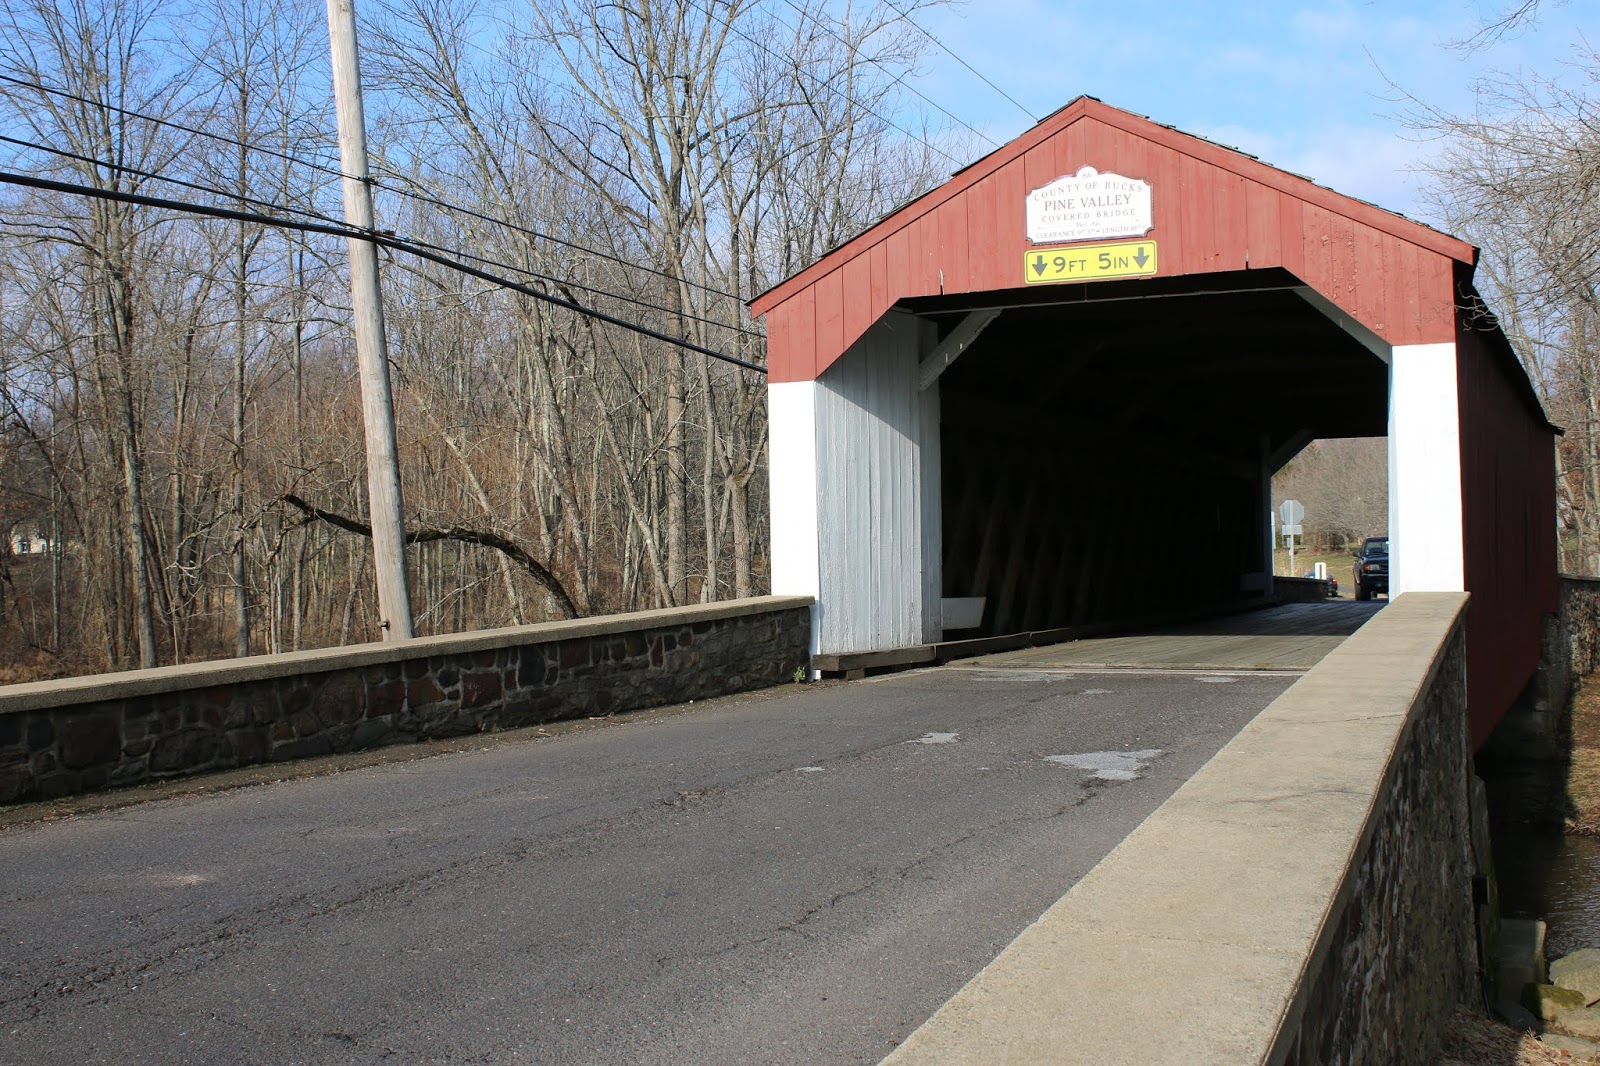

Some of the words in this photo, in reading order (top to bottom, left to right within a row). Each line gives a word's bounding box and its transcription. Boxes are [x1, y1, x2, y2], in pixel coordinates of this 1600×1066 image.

[1034, 183, 1081, 201] COUNTY
[1085, 182, 1098, 190] OF
[1105, 182, 1143, 193] BUCKS
[1044, 198, 1075, 211] PINE
[1080, 193, 1132, 208] VALLEY
[1041, 213, 1090, 223] COVERED
[1096, 208, 1136, 218] BRIDGE
[1036, 230, 1075, 239] CLEARANCE
[1102, 226, 1129, 234] LENGTH
